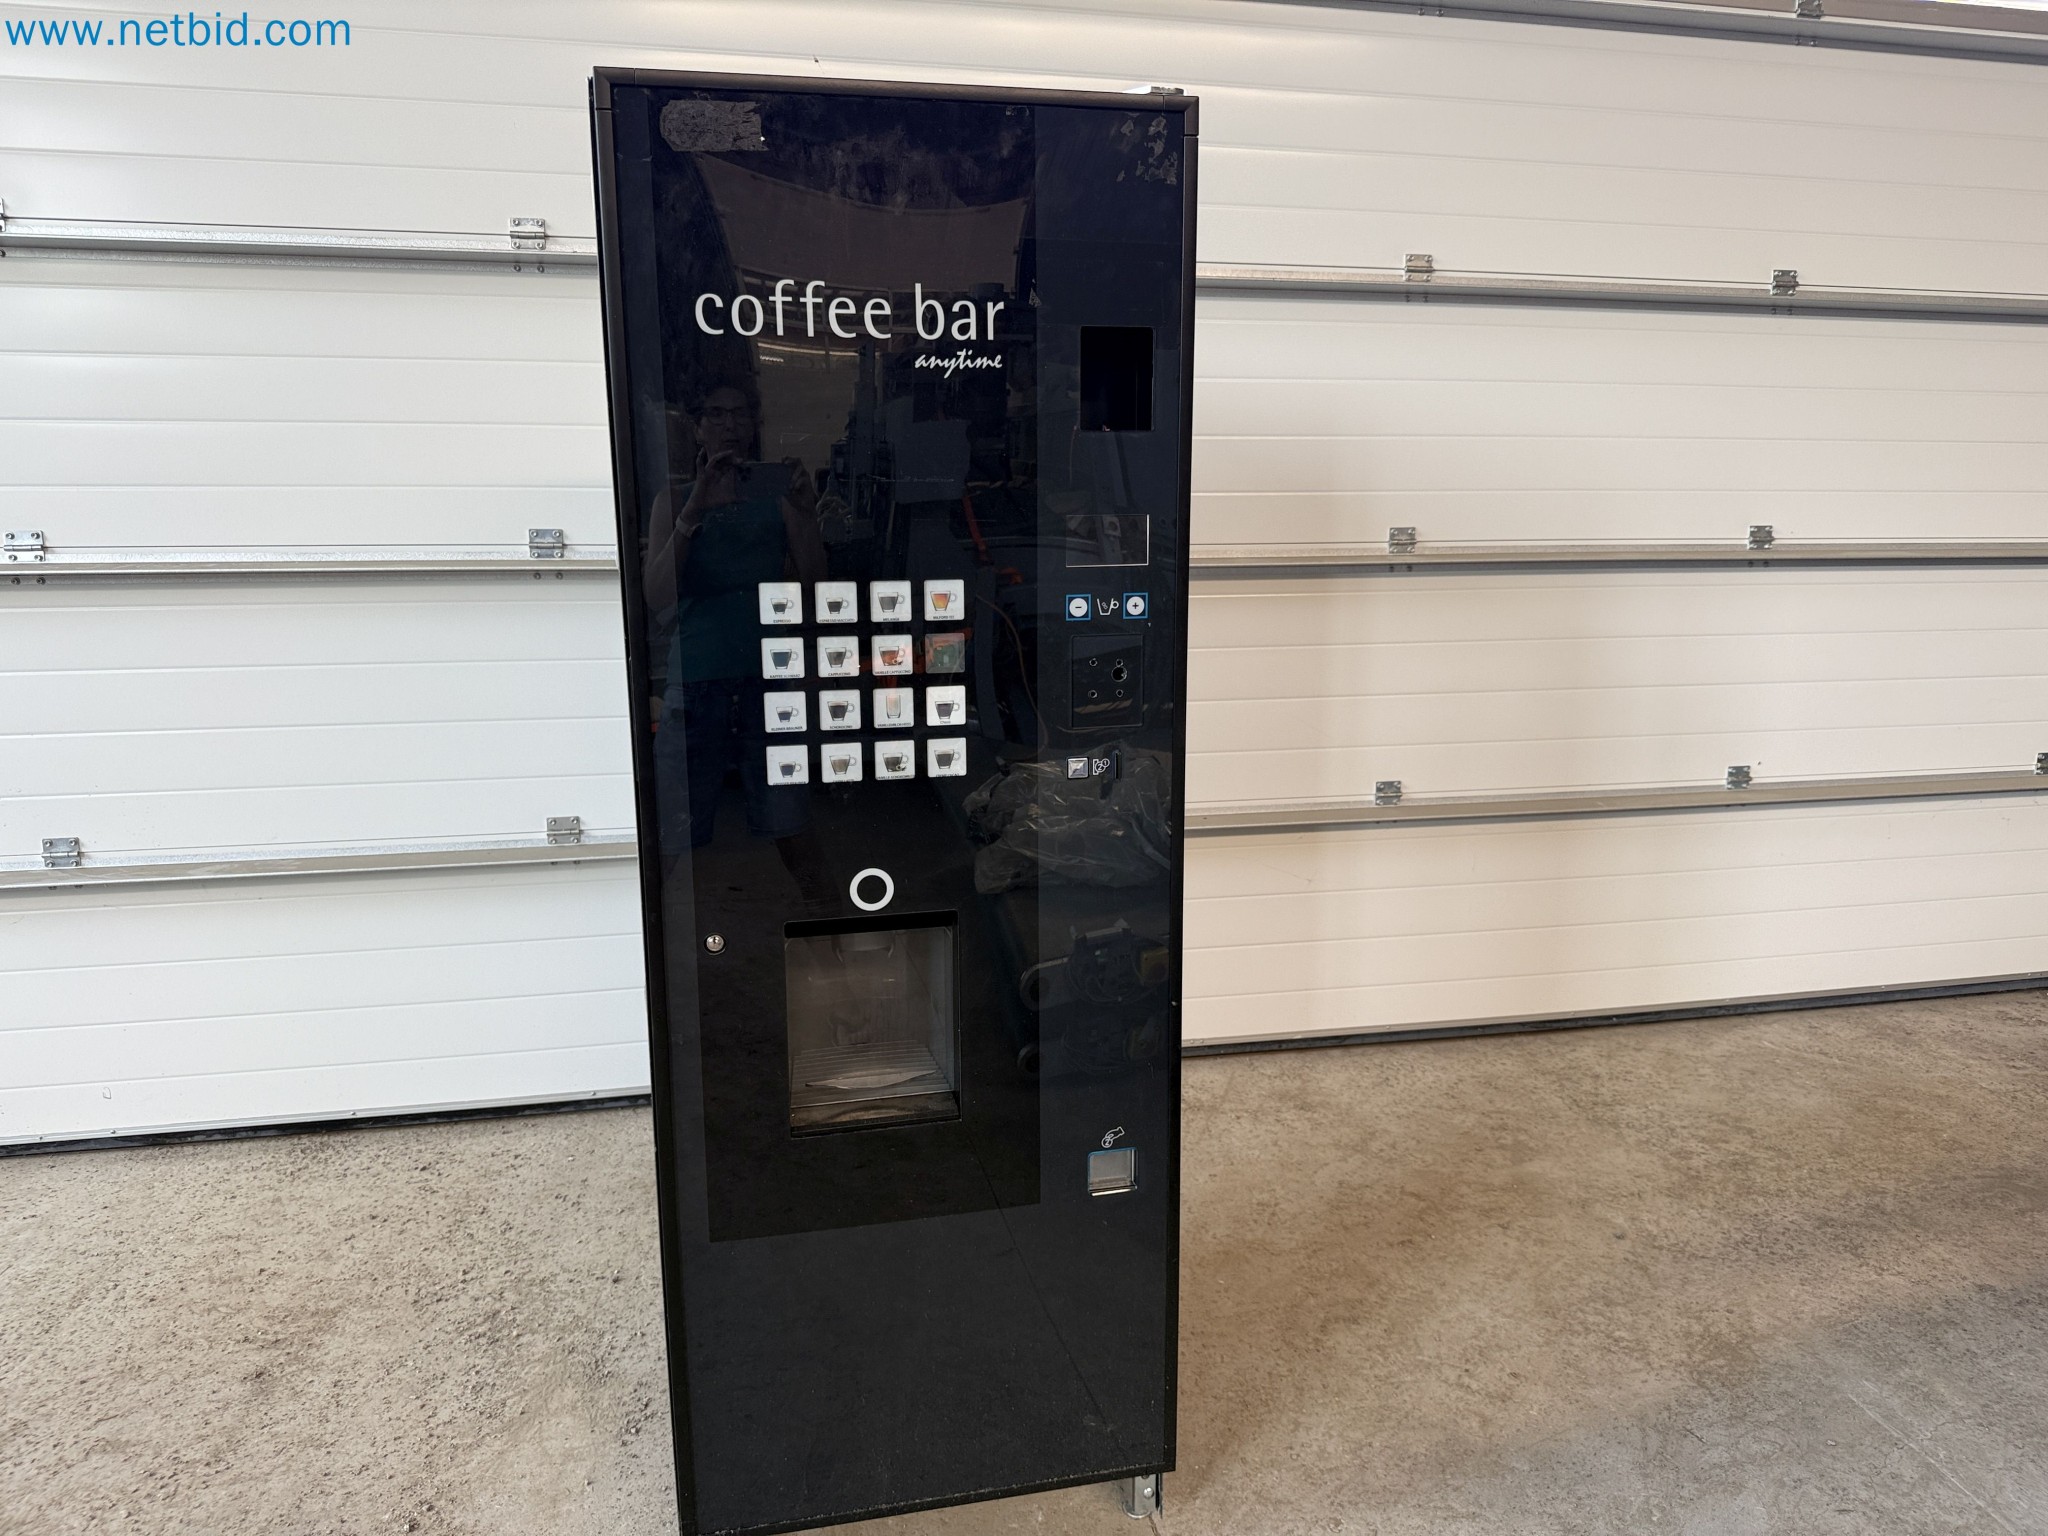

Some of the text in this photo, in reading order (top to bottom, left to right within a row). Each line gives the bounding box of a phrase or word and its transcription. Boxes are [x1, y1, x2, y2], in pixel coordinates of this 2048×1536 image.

[695, 279, 1005, 341] coffee bar
[914, 348, 1003, 379] anytime
